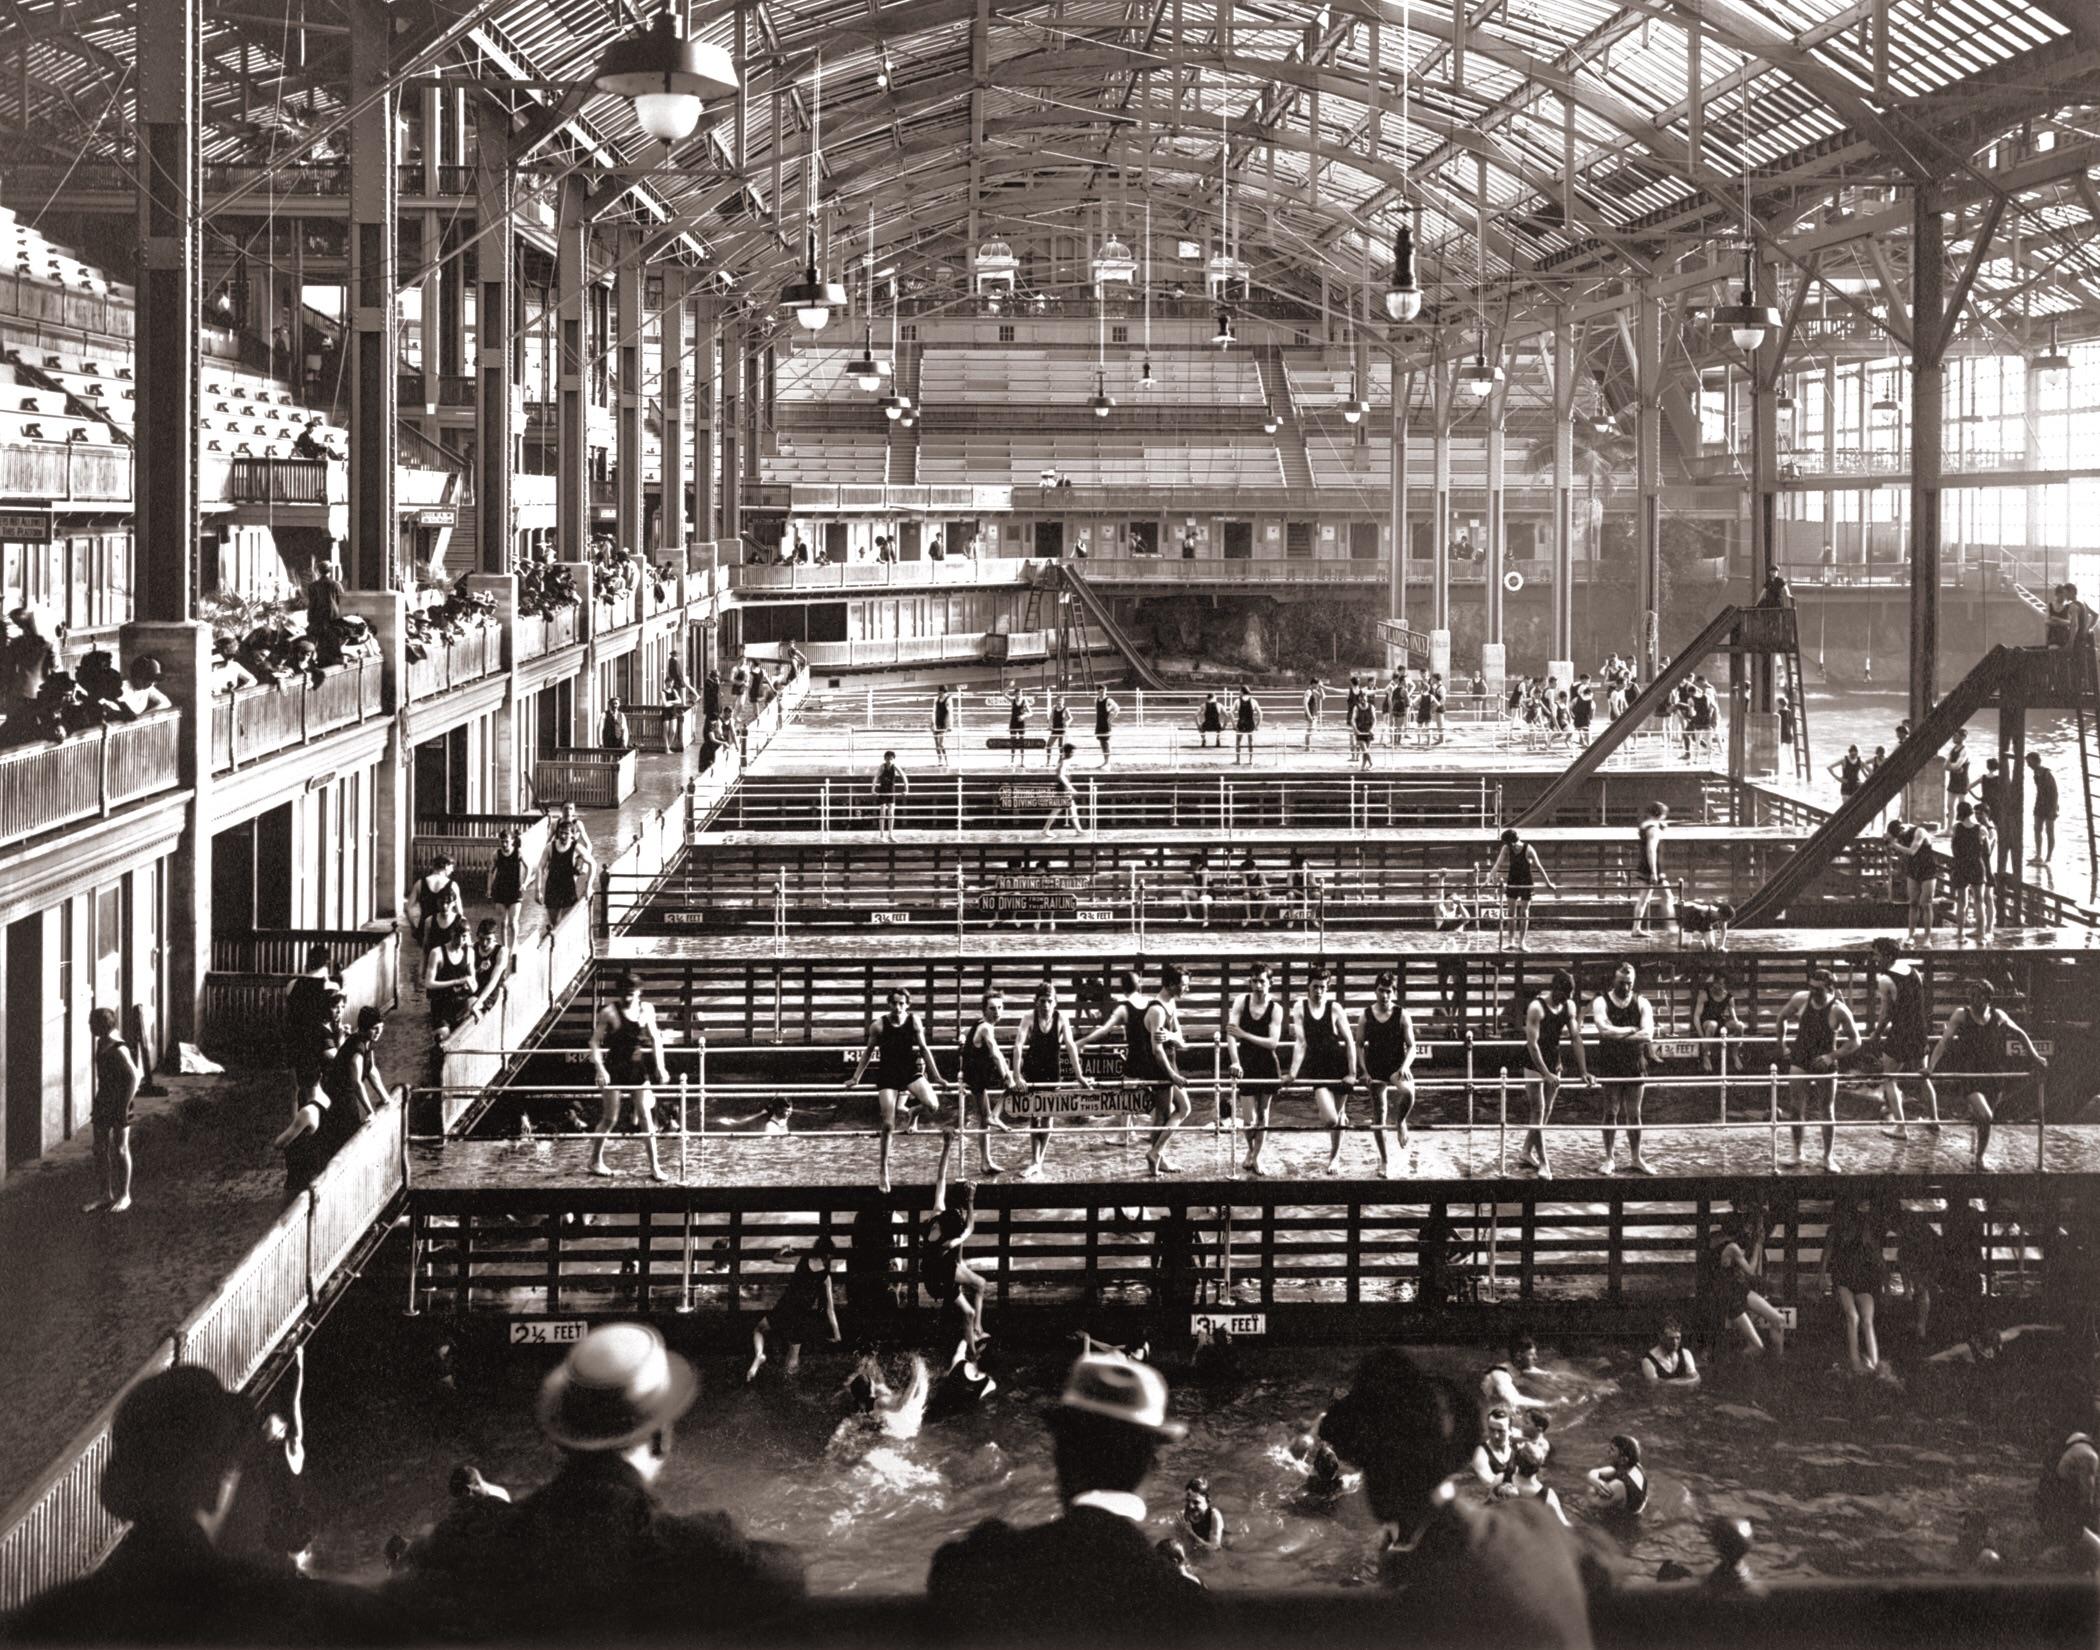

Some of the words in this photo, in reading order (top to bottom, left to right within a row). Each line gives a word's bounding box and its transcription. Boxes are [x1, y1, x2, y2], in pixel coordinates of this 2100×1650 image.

[1002, 799, 1012, 808] NO
[1014, 799, 1037, 808] DIVING
[1000, 879, 1011, 889] NO
[1013, 879, 1040, 889] DIVING
[1055, 878, 1089, 889] RAILING
[982, 897, 995, 910] NO
[998, 896, 1027, 910] DIVING
[1044, 897, 1075, 910] RAILING
[892, 913, 907, 922] FEET
[1097, 912, 1111, 920] FEET
[1676, 1044, 1695, 1055] FEET
[1011, 1093, 1030, 1113] NO
[1033, 1093, 1079, 1113] DIVING
[1080, 1103, 1100, 1112] THIS
[1100, 1092, 1149, 1113] RAILING
[1231, 1317, 1259, 1332] FEET
[515, 1324, 546, 1344] 2½
[553, 1324, 582, 1340] FEET
